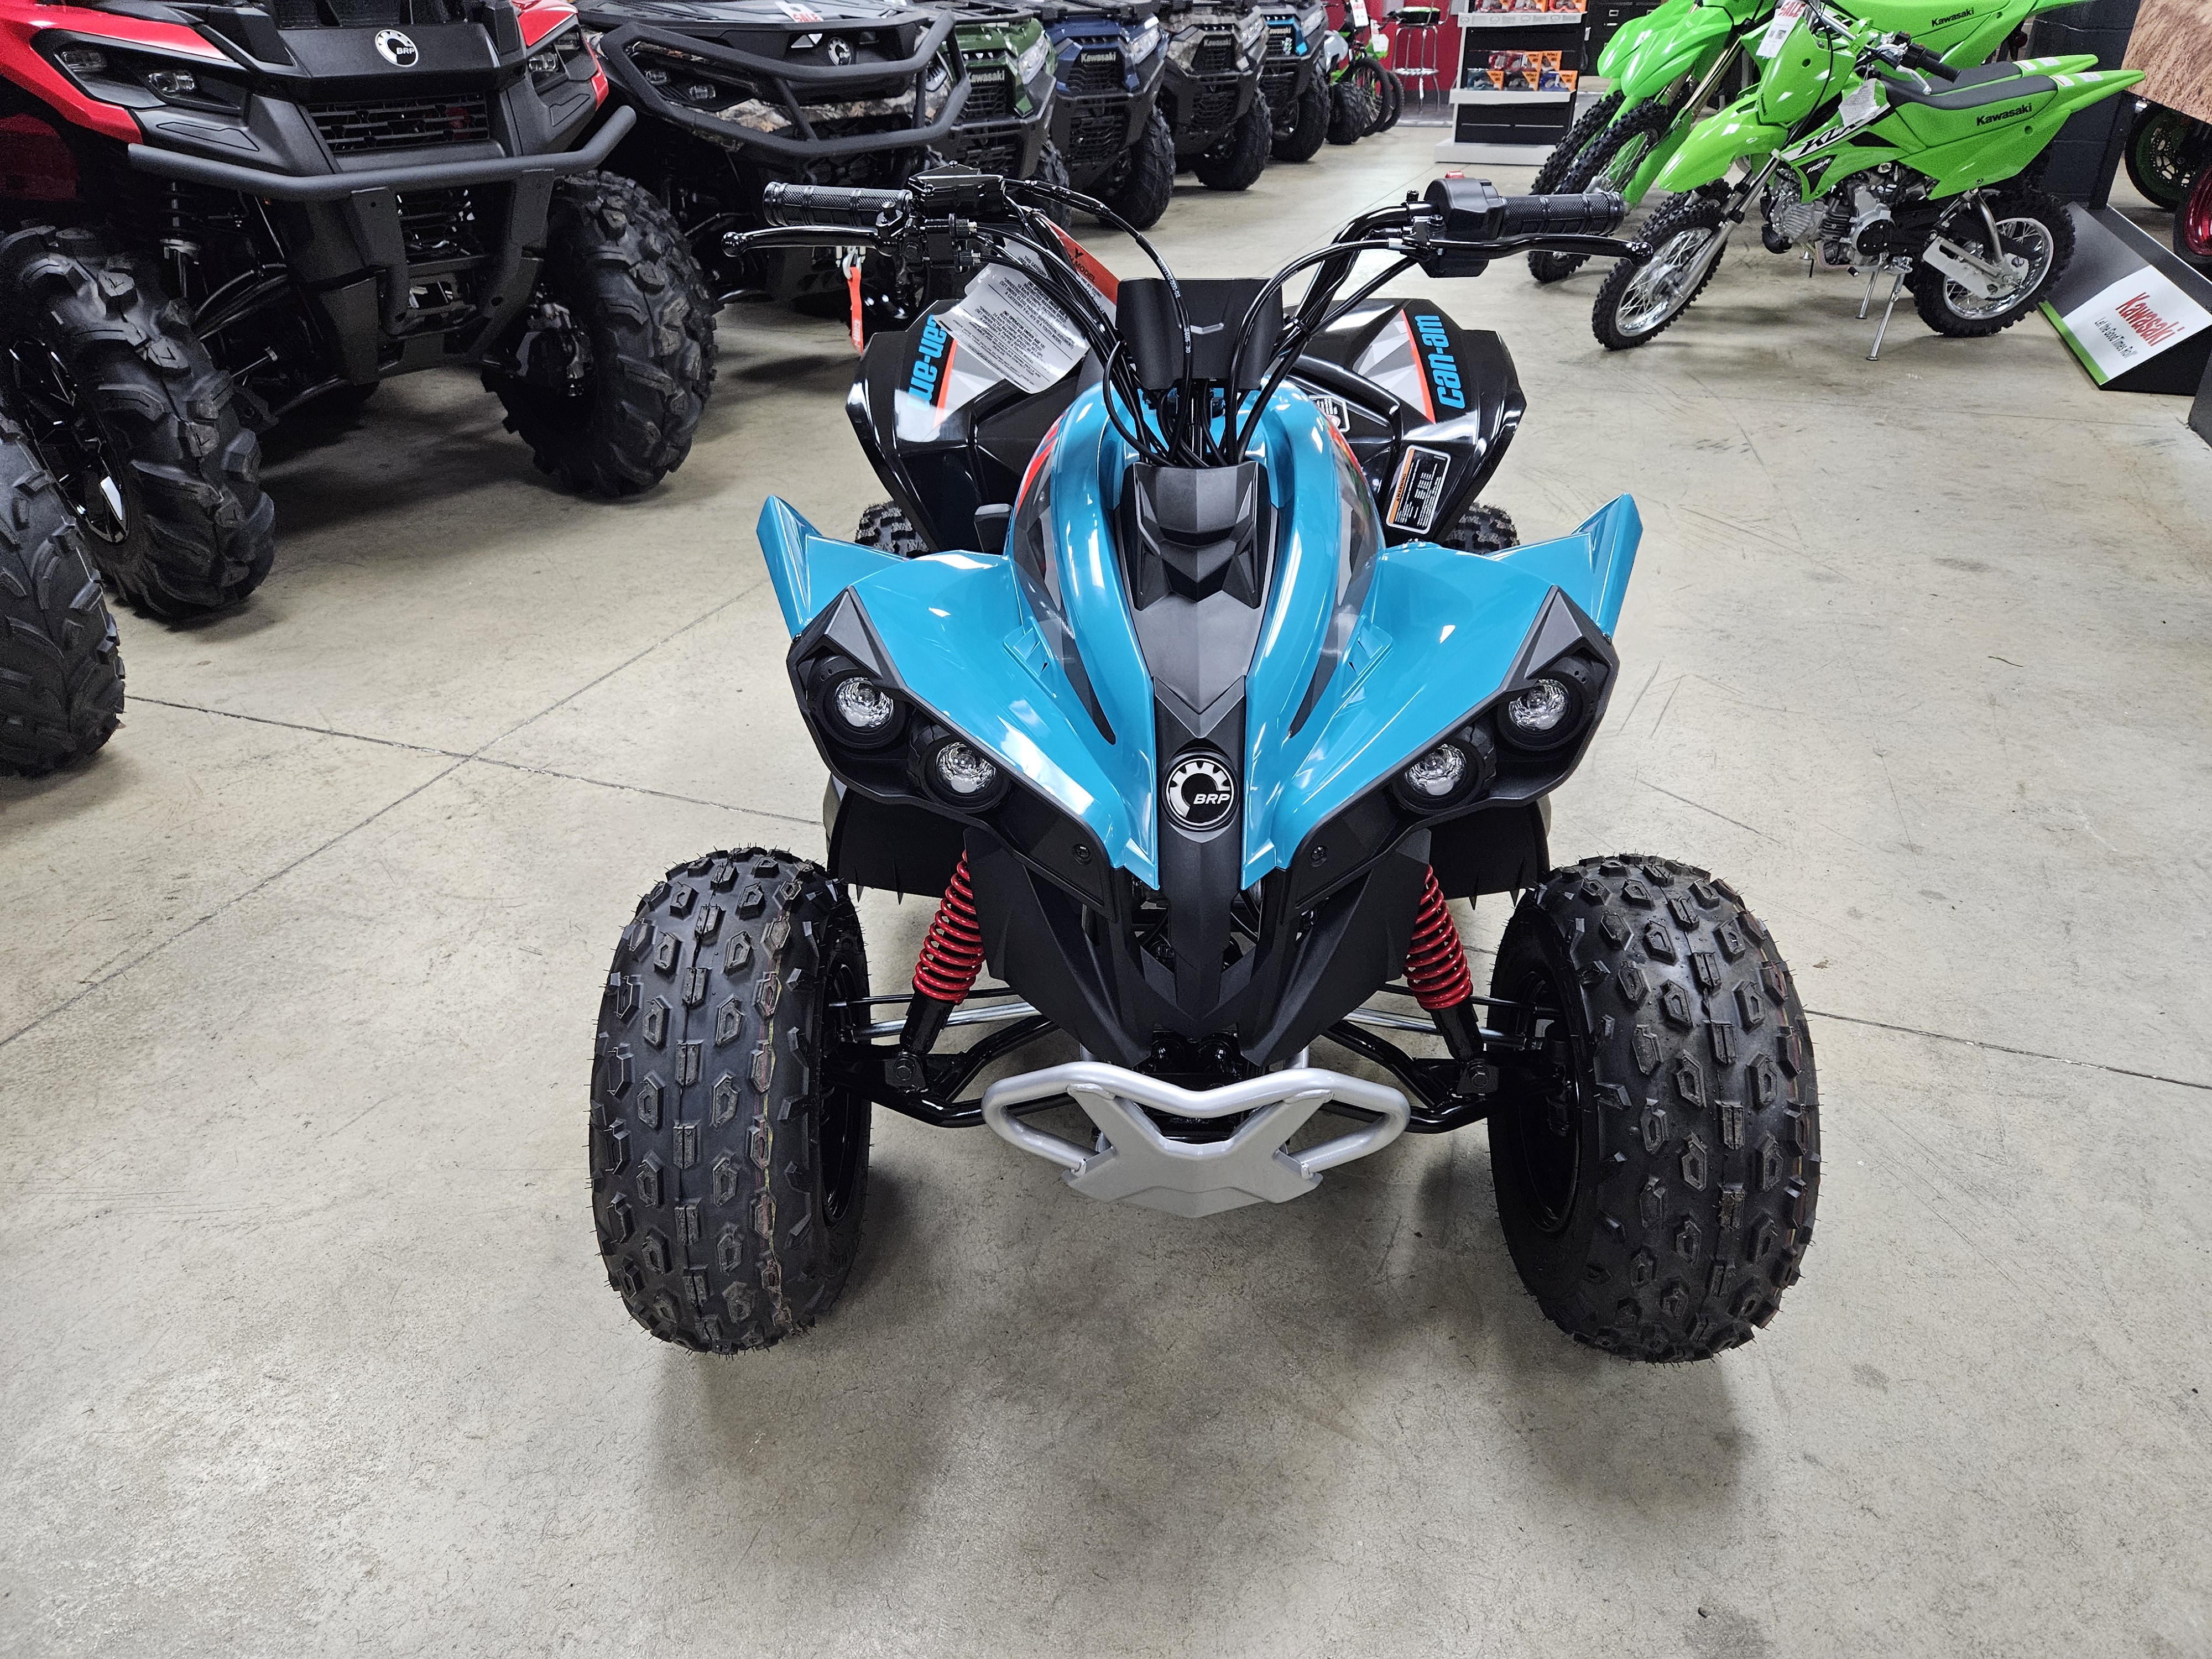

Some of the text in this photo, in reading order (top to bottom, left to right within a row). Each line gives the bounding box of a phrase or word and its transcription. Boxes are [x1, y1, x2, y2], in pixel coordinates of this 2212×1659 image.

[793, 13, 822, 22] SALE
[1778, 1, 1806, 17] SALE
[1932, 7, 1974, 27] Kawasaki
[1081, 51, 1116, 62] Kawasaki
[967, 70, 1005, 83] Kawasaki
[1976, 103, 2032, 126] Kawasaki
[1030, 262, 1047, 277] CATEGORY
[1073, 261, 1097, 283] MODEL
[999, 280, 1008, 289] (SET
[1006, 286, 1018, 297] UNDER
[1016, 295, 1027, 306] CLOSE
[1025, 304, 1038, 316] PARENT
[1022, 283, 1042, 300] RESTRICTED
[1040, 299, 1057, 314] MAXIMUM
[1032, 286, 1050, 301] OPERATOR
[982, 314, 993, 324] UNDER
[992, 322, 1003, 332] CLOSE
[1001, 331, 1014, 342] PARENT
[999, 313, 1018, 330] RESTRICTED
[1016, 328, 1032, 343] MAXIMUM
[1006, 293, 1024, 309] CATEGORY
[1041, 325, 1052, 335] YOUTH
[1051, 333, 1063, 345] MODEL
[1008, 315, 1024, 330] OPERATOR
[1023, 328, 1034, 339] UNDER
[2094, 317, 2107, 327] Let
[2099, 322, 2111, 332] the
[2115, 292, 2185, 346] Kawasaki
[982, 319, 998, 333] CATEGORY
[1013, 346, 1024, 355] YOUTH
[1001, 326, 1016, 340] MAXIMUM
[2105, 328, 2122, 341] Good
[2111, 336, 2127, 351] Times
[906, 314, 948, 411] can-am
[1415, 315, 1465, 409] can-am
[1397, 473, 1407, 500] WARNING
[1193, 793, 1231, 805] BRP
